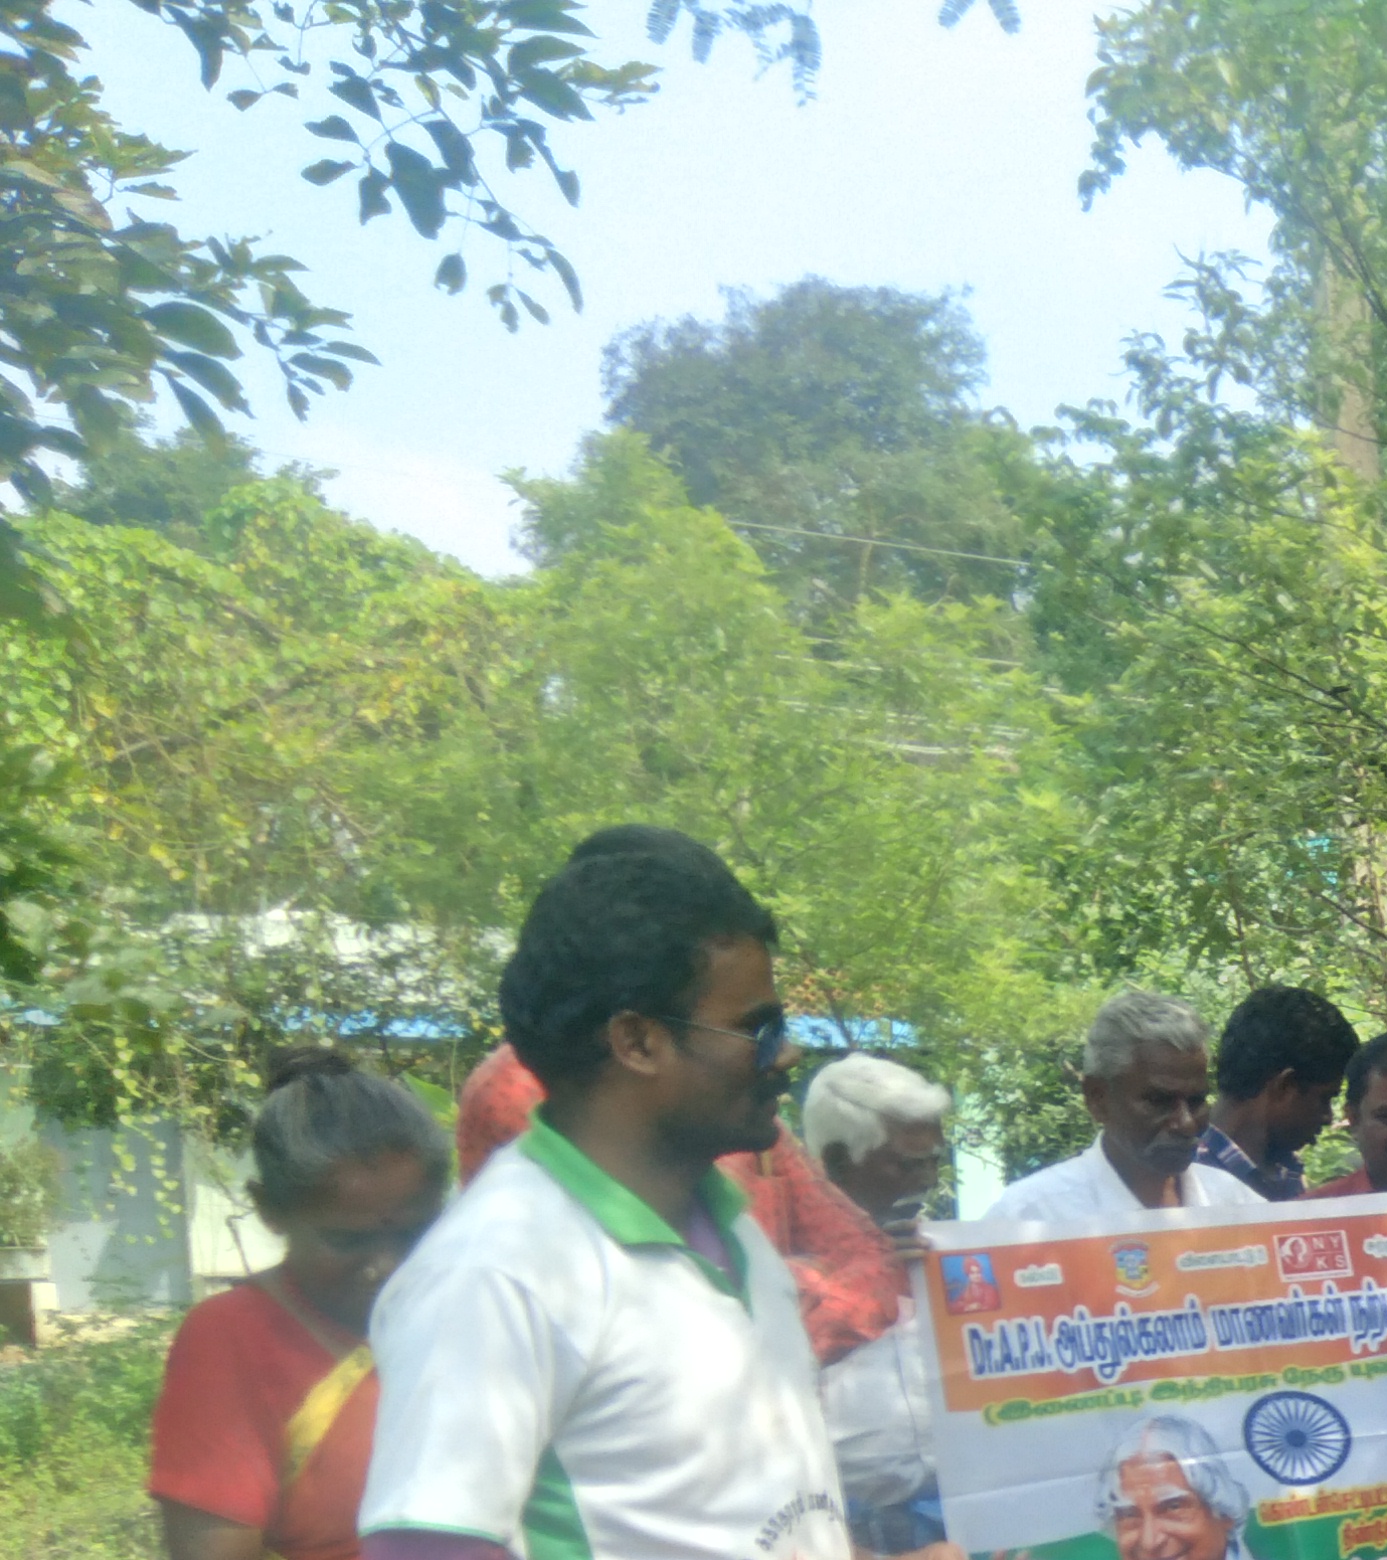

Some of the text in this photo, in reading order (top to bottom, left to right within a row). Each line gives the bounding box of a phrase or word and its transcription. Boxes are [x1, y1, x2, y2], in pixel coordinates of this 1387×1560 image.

[967, 1320, 1053, 1378] Dr.A.P.J.
[1054, 1299, 1207, 1380] அப்துல்கலாம்
[1211, 1283, 1347, 1349] மாணவர்கள்
